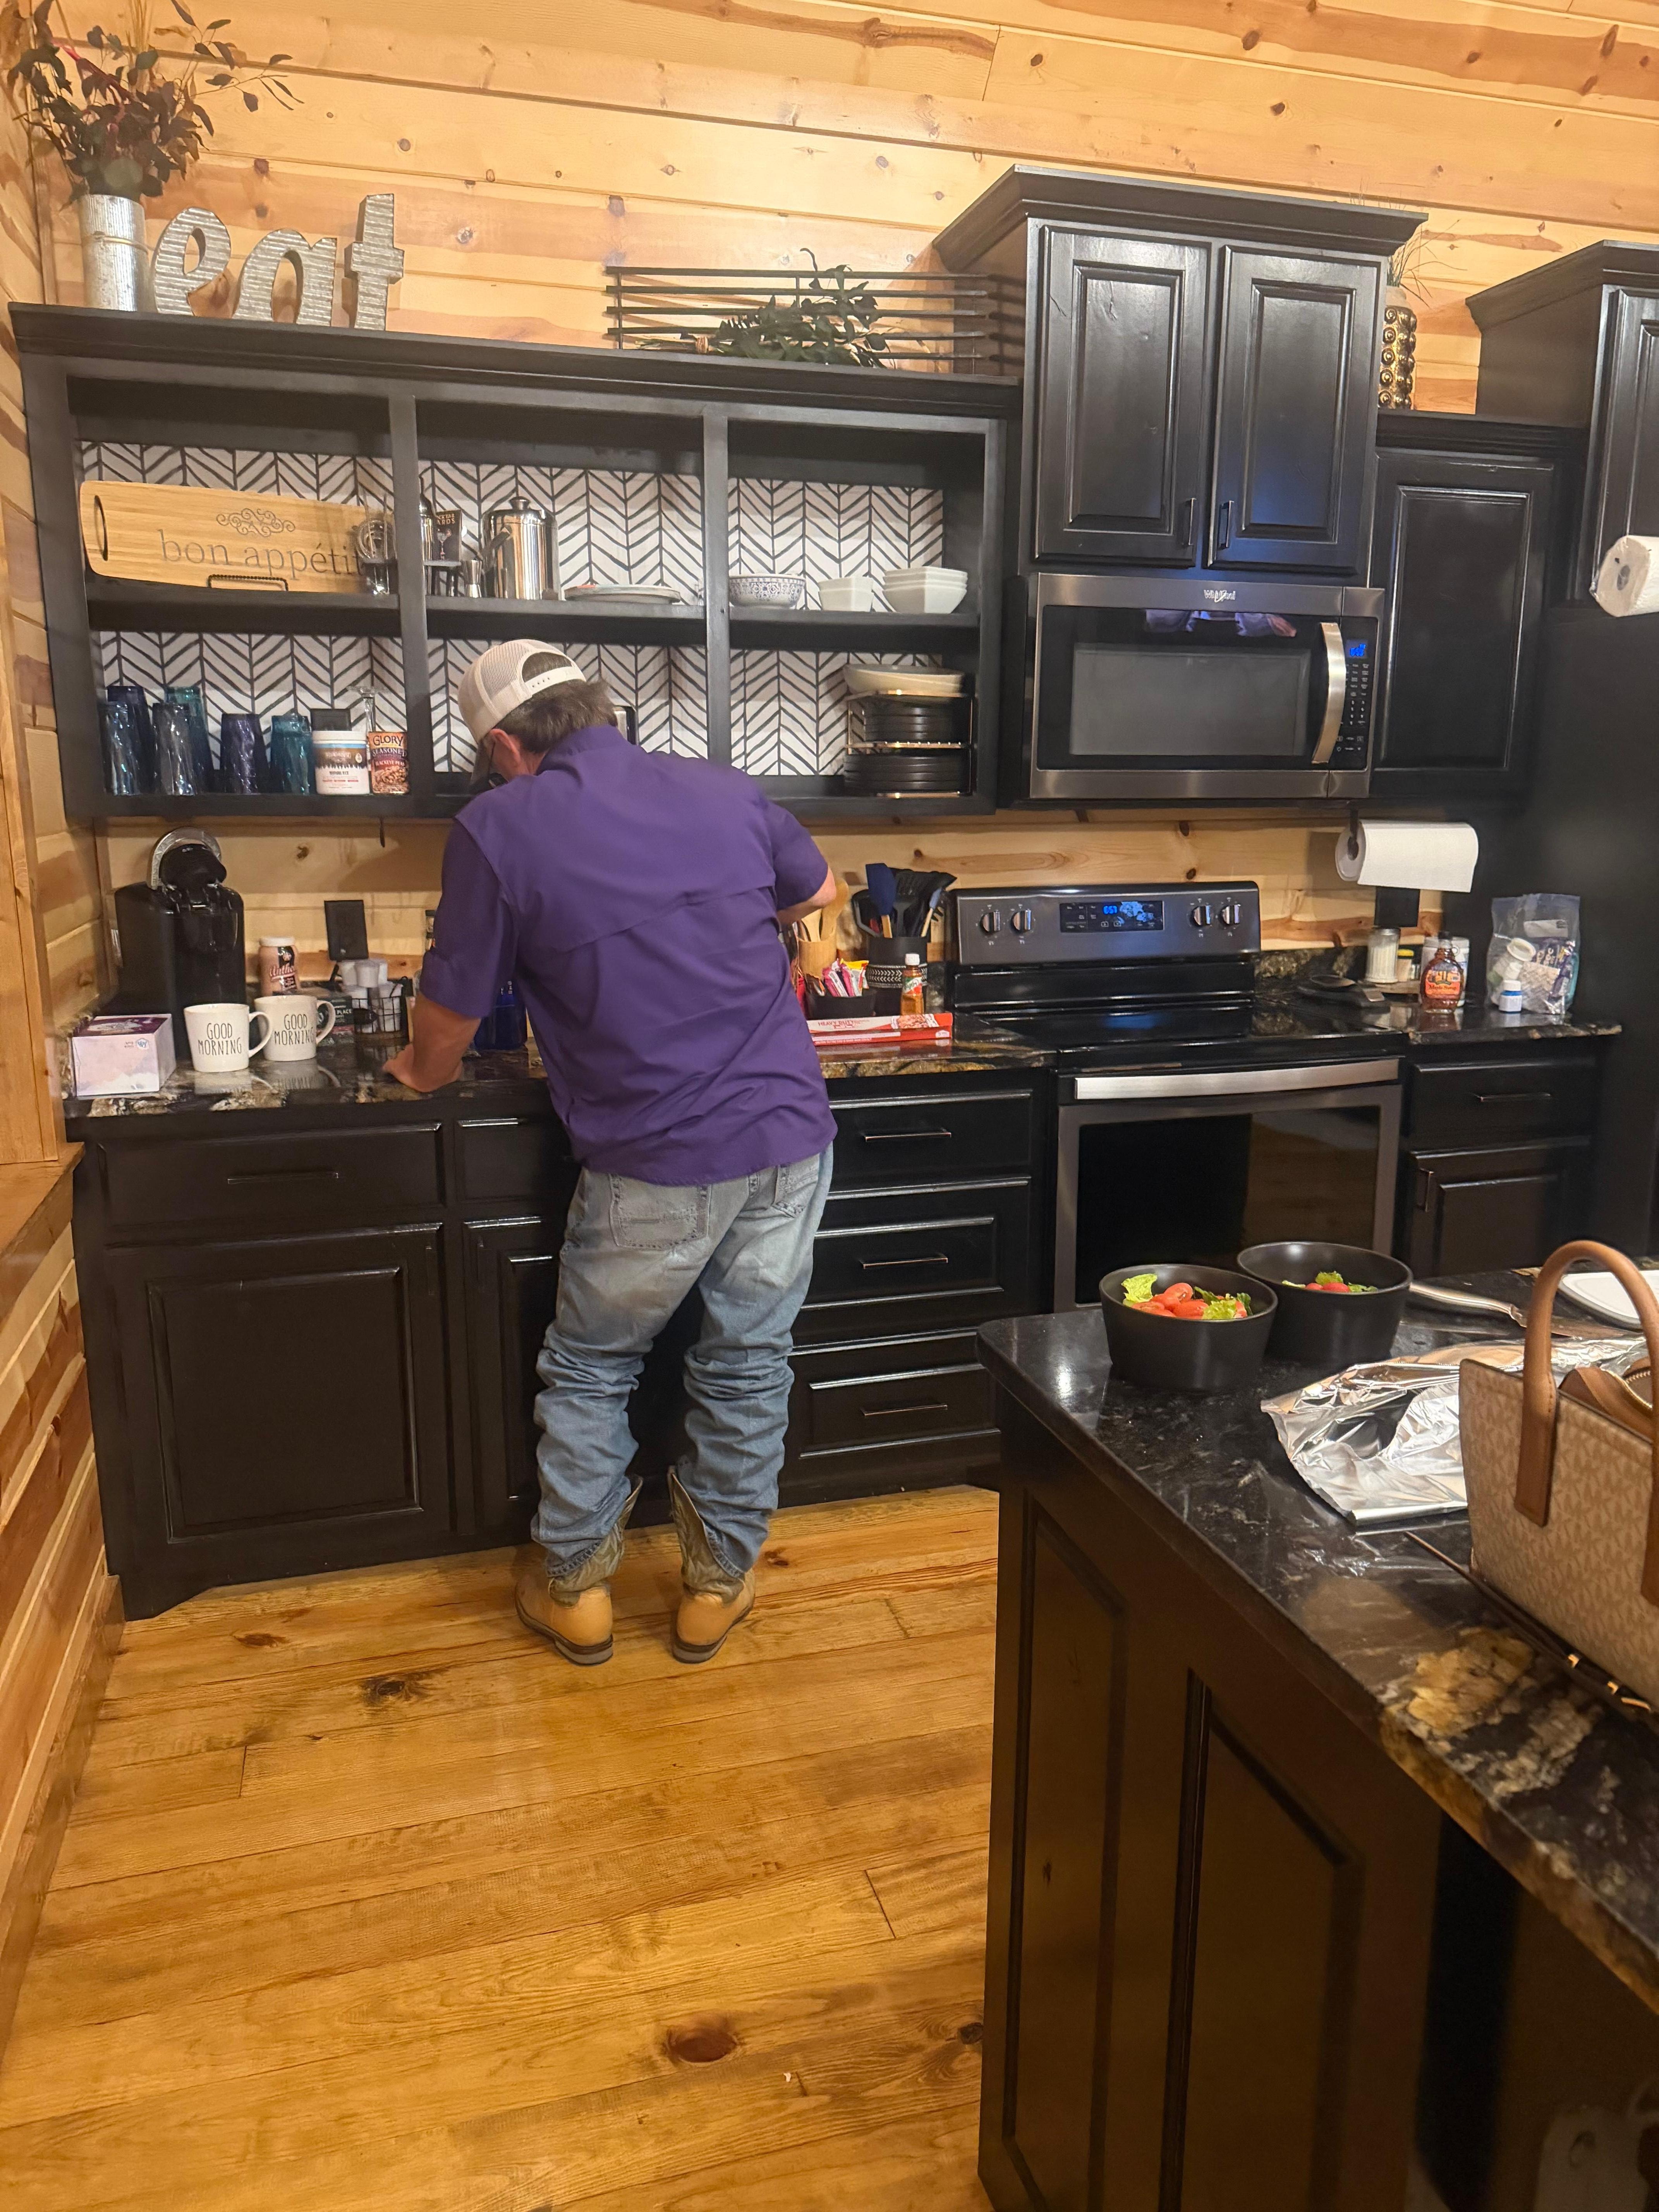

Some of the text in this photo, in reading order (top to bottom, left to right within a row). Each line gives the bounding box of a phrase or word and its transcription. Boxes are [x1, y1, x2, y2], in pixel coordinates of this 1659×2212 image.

[152, 193, 404, 331] eat
[157, 529, 362, 580] bon appétit
[373, 735, 403, 747] GLORY
[372, 748, 407, 757] SEASONED
[284, 1014, 307, 1030] GOOD
[207, 1023, 232, 1039] GOOD
[274, 1027, 315, 1045] MORNING
[198, 1037, 242, 1056] MORNING
